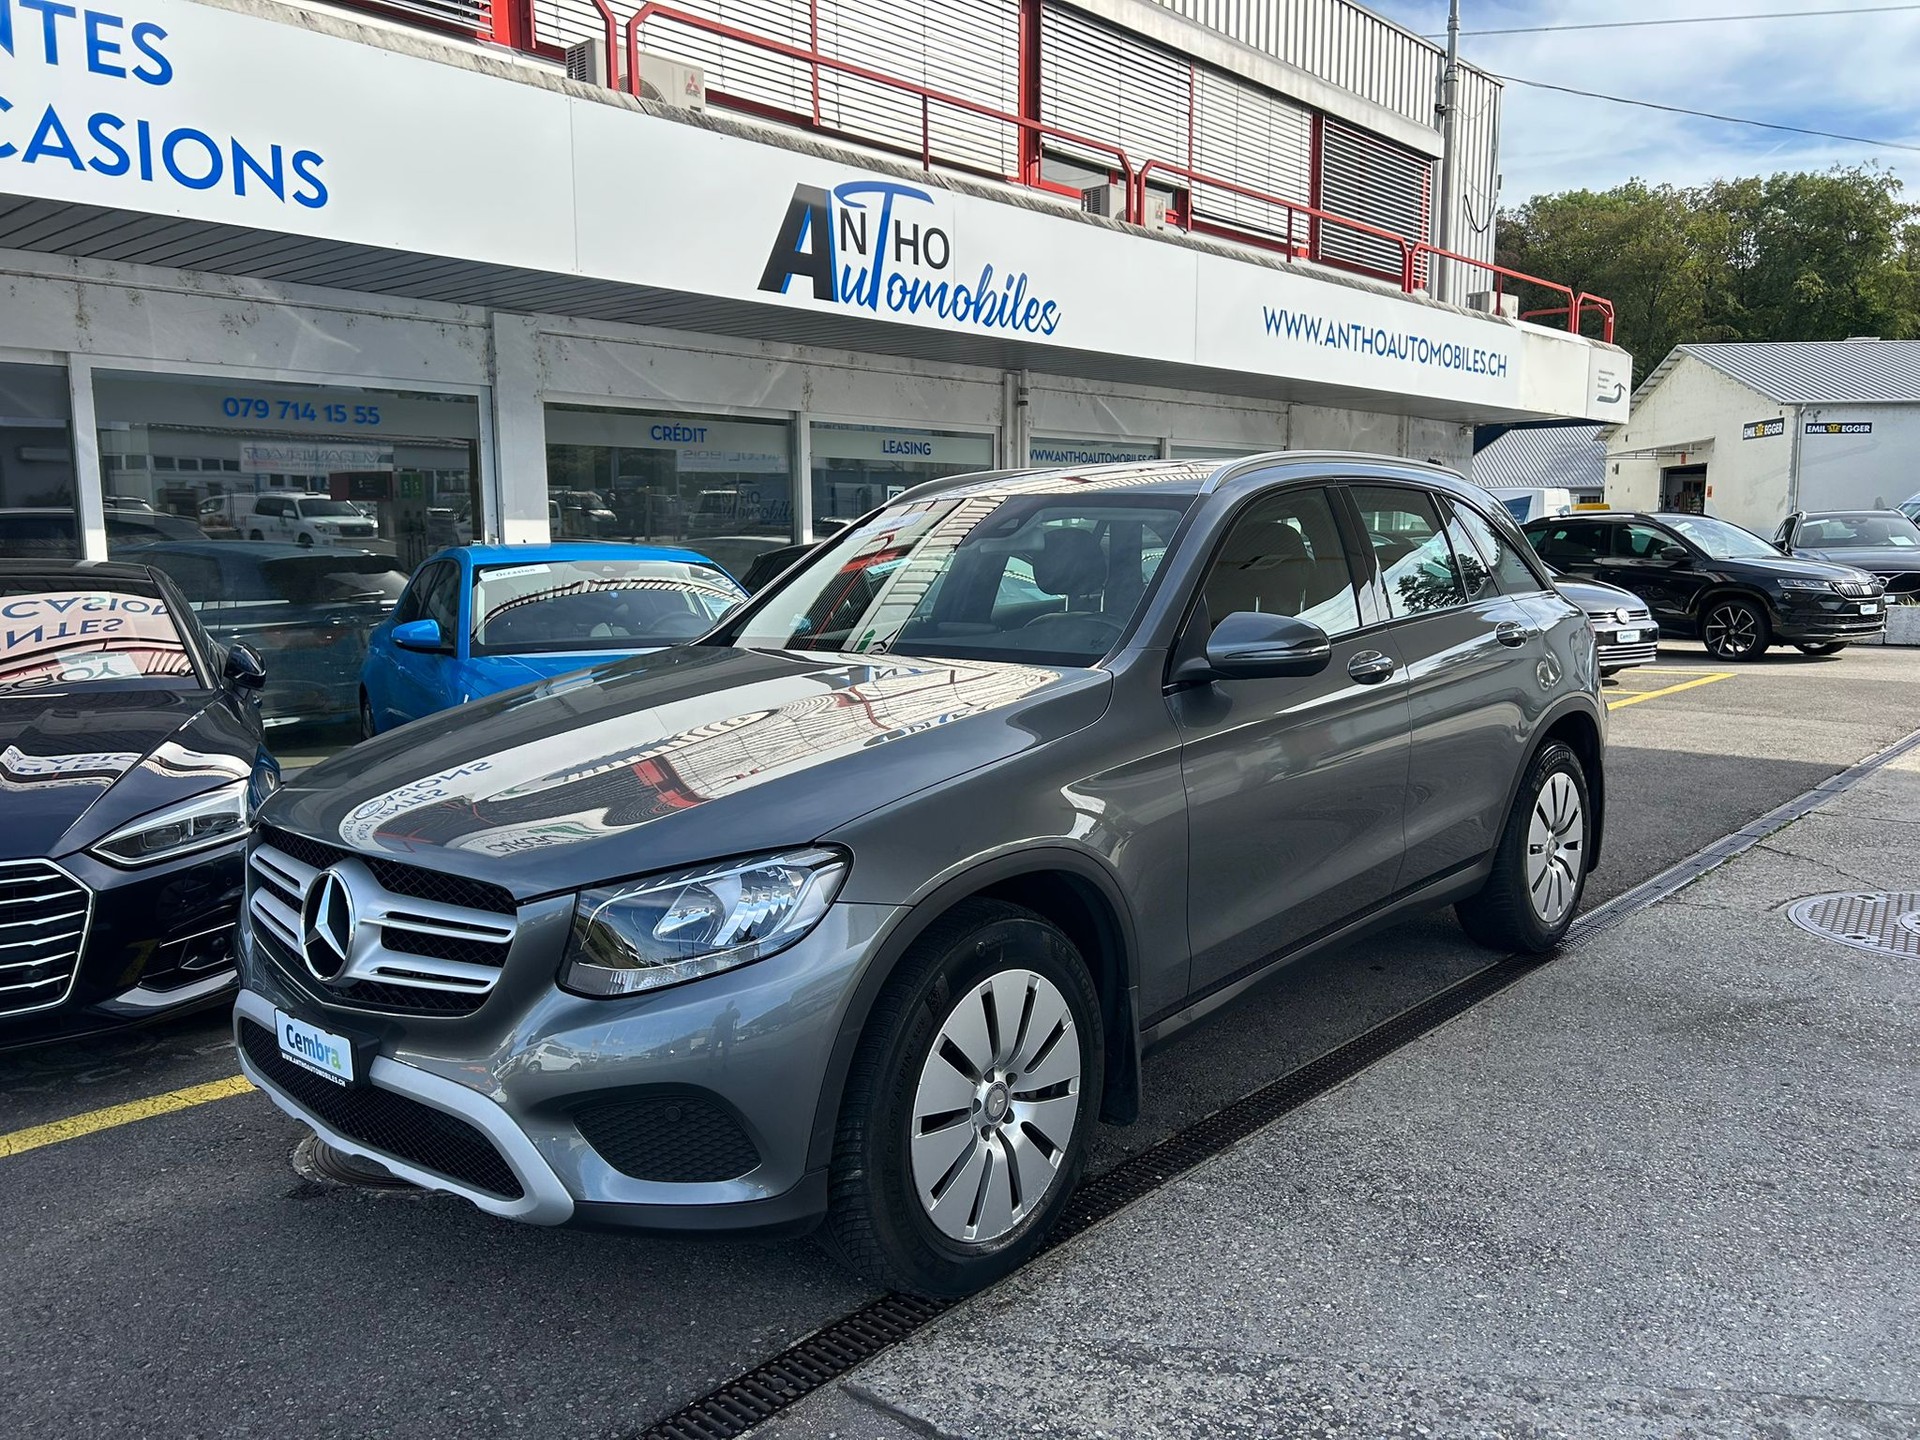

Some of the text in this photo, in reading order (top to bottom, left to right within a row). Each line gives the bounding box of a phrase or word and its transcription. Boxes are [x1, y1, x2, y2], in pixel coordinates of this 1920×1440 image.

[1263, 306, 1507, 378] WWW.ANTHOAUTOMOBILES.CH
[223, 397, 381, 425] 079 714 15 55
[651, 422, 707, 443] CRÉDIT
[1764, 422, 1783, 435] EGGER
[1807, 425, 1870, 433] EMIL EGGER
[882, 440, 932, 456] LEASING
[286, 1024, 341, 1070] Cembra
